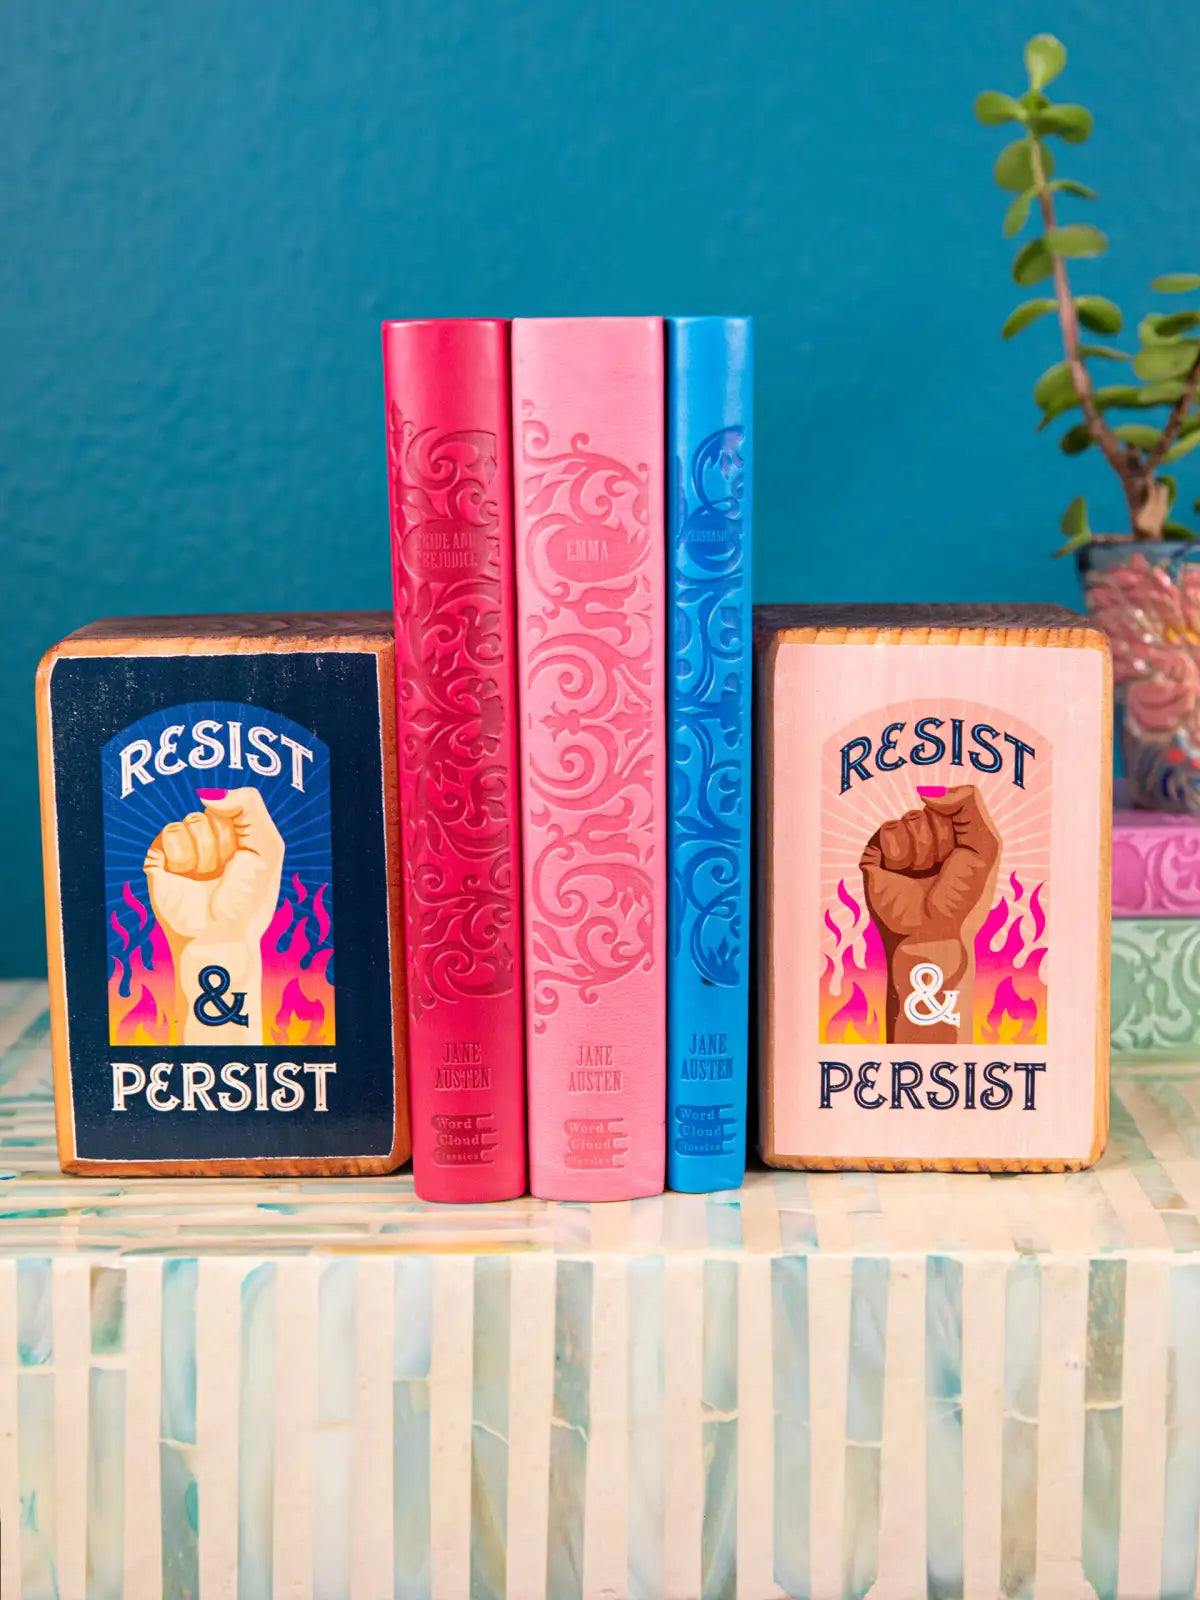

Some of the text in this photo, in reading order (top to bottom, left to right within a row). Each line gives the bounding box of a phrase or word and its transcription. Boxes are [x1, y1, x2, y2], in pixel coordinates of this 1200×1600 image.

[566, 539, 609, 563] EMMA
[119, 718, 315, 800] RESIST
[838, 716, 1037, 796] RESIST
[193, 964, 249, 1029] &
[904, 961, 961, 1028] &
[442, 1042, 482, 1065] JANE
[576, 1044, 614, 1067] JANE
[688, 1032, 728, 1056] JANE
[434, 1067, 492, 1091] AUSTEN
[680, 1057, 735, 1082] AUSTEN
[110, 1061, 338, 1113] PERSIST
[568, 1071, 623, 1094] AUSTEN
[818, 1060, 1047, 1111] PERSIST
[436, 1117, 473, 1130] Word
[680, 1108, 716, 1121] Word
[569, 1121, 604, 1134] Word
[682, 1125, 722, 1137] Cloud
[440, 1134, 479, 1146] Cloud
[571, 1138, 611, 1150] Cloud
